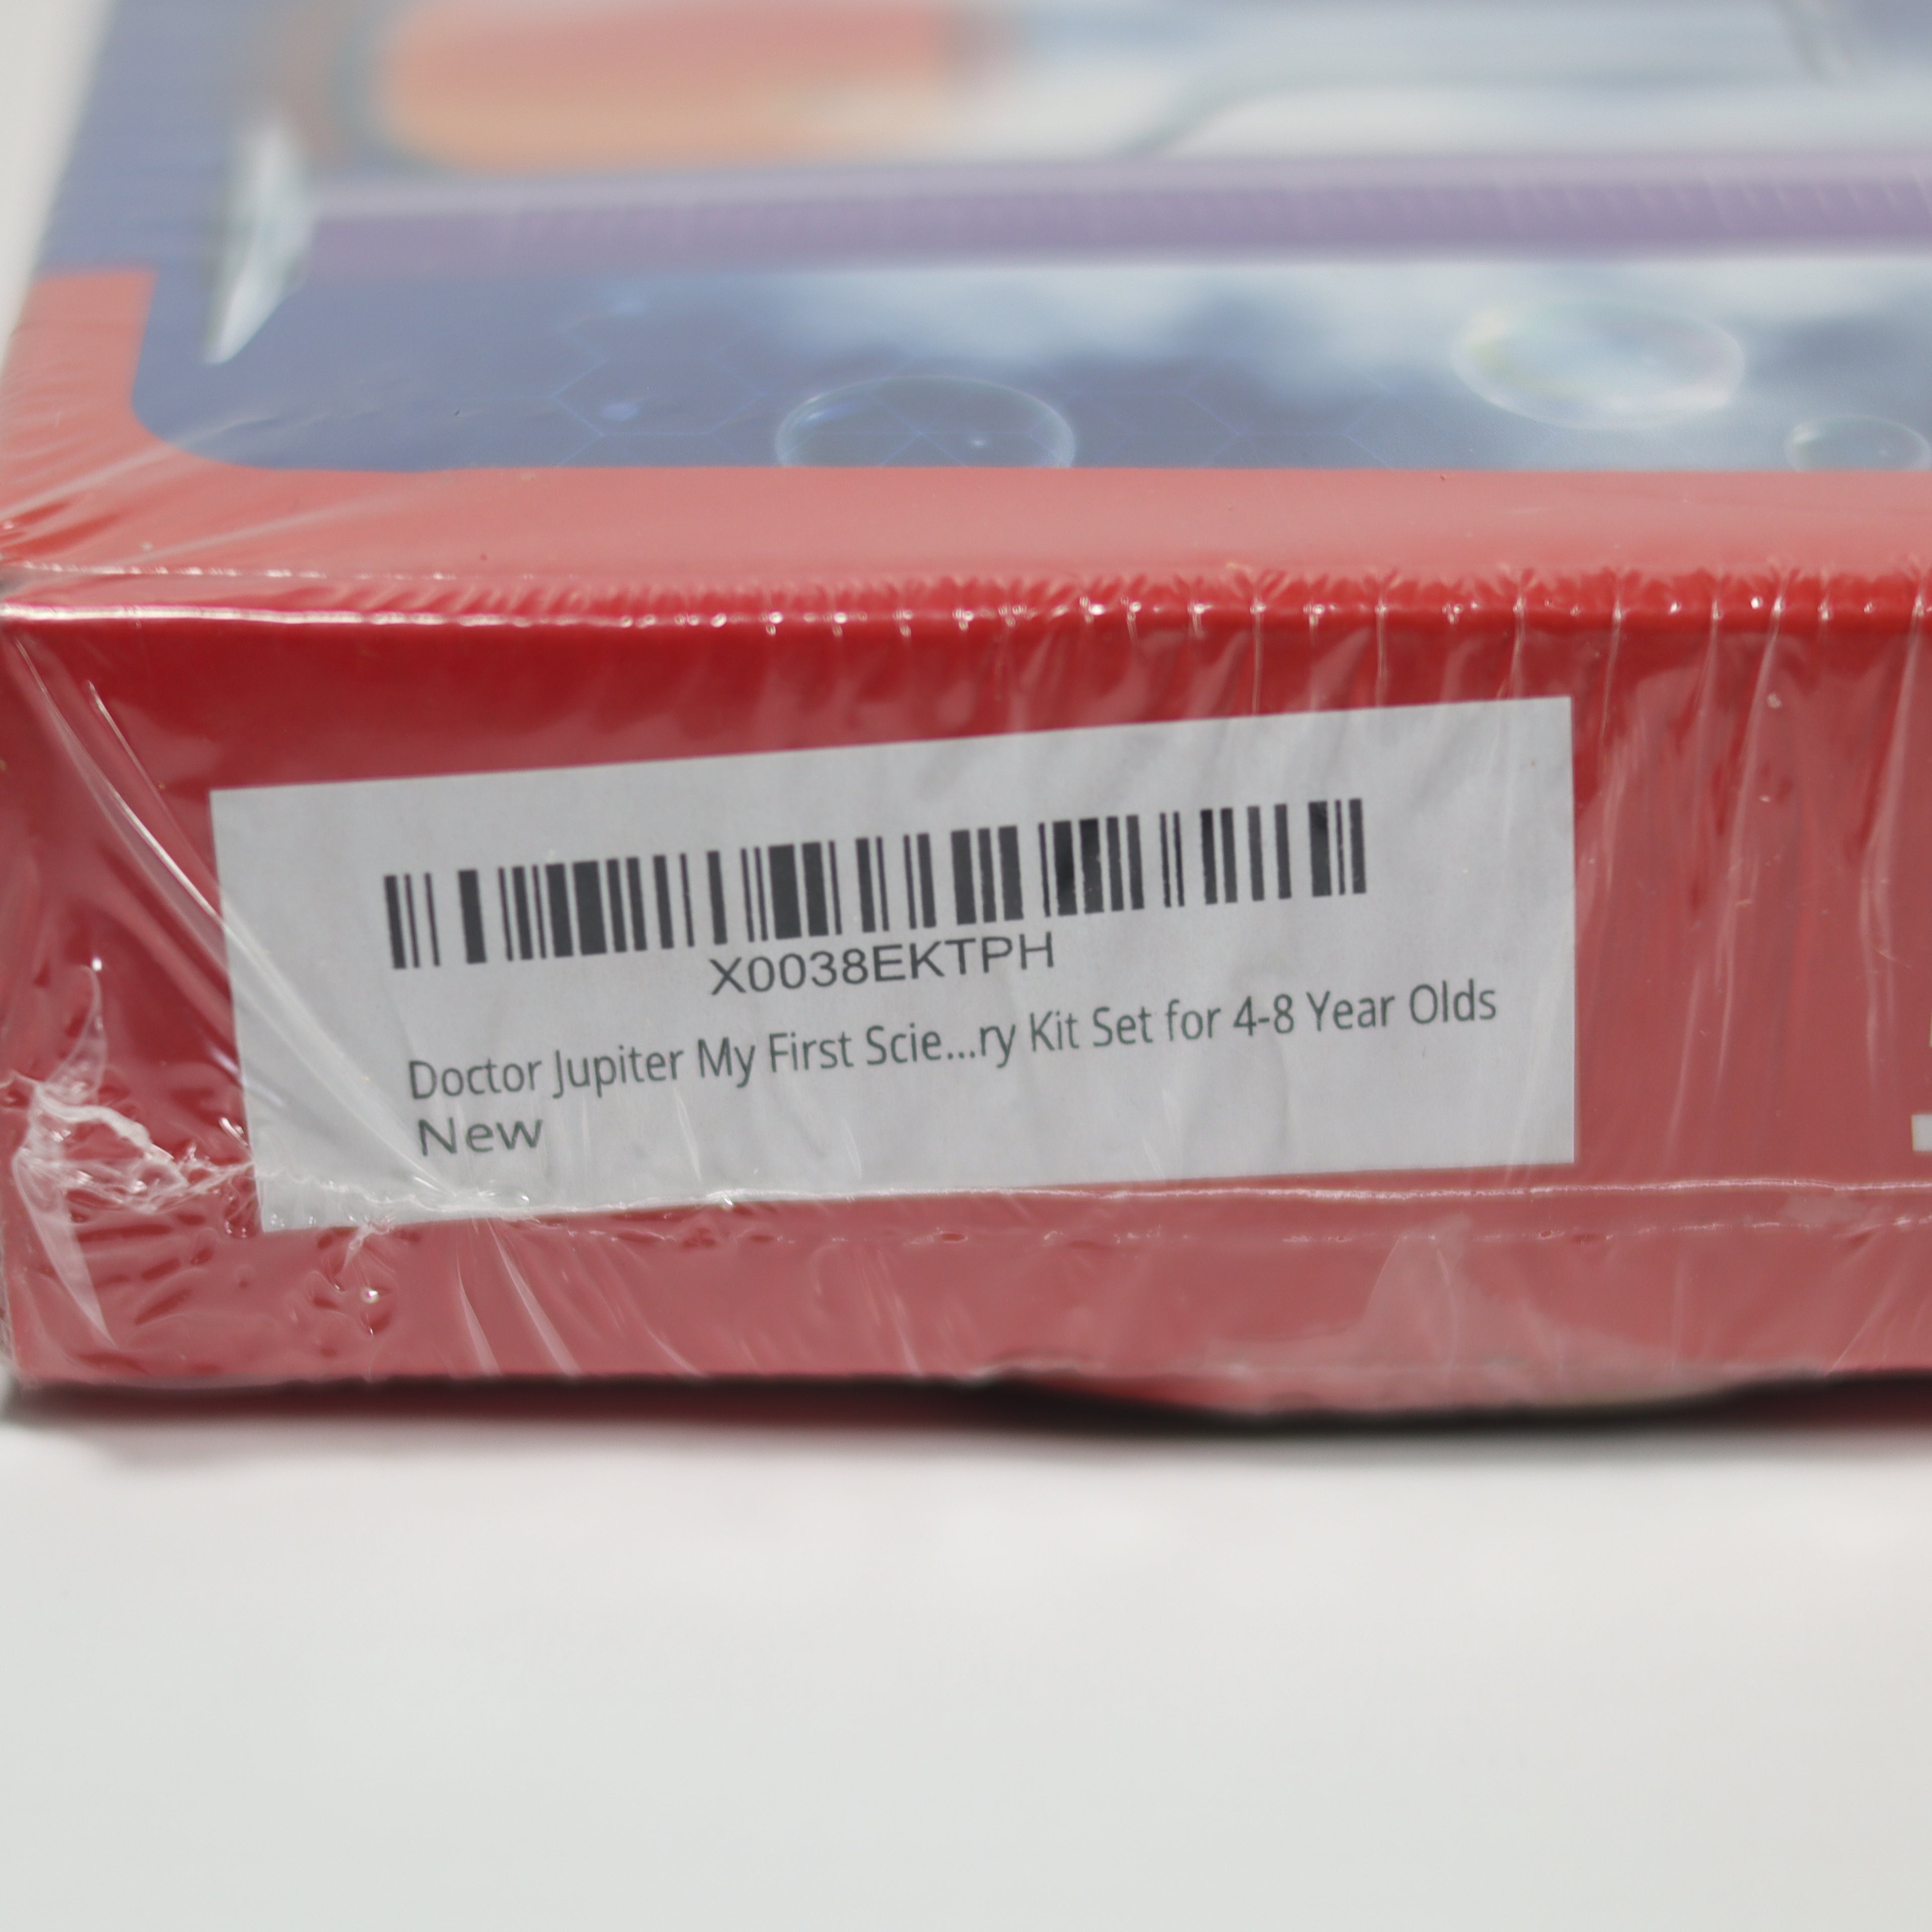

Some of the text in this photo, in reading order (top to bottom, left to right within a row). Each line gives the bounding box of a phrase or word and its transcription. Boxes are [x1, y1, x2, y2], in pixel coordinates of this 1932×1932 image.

[710, 930, 1055, 996] X0038EKTPH
[408, 978, 1497, 1099] Doctor Jupiter My First Scie...ry Kit Set for 4-8 Year Olds
[417, 1115, 543, 1157] New
